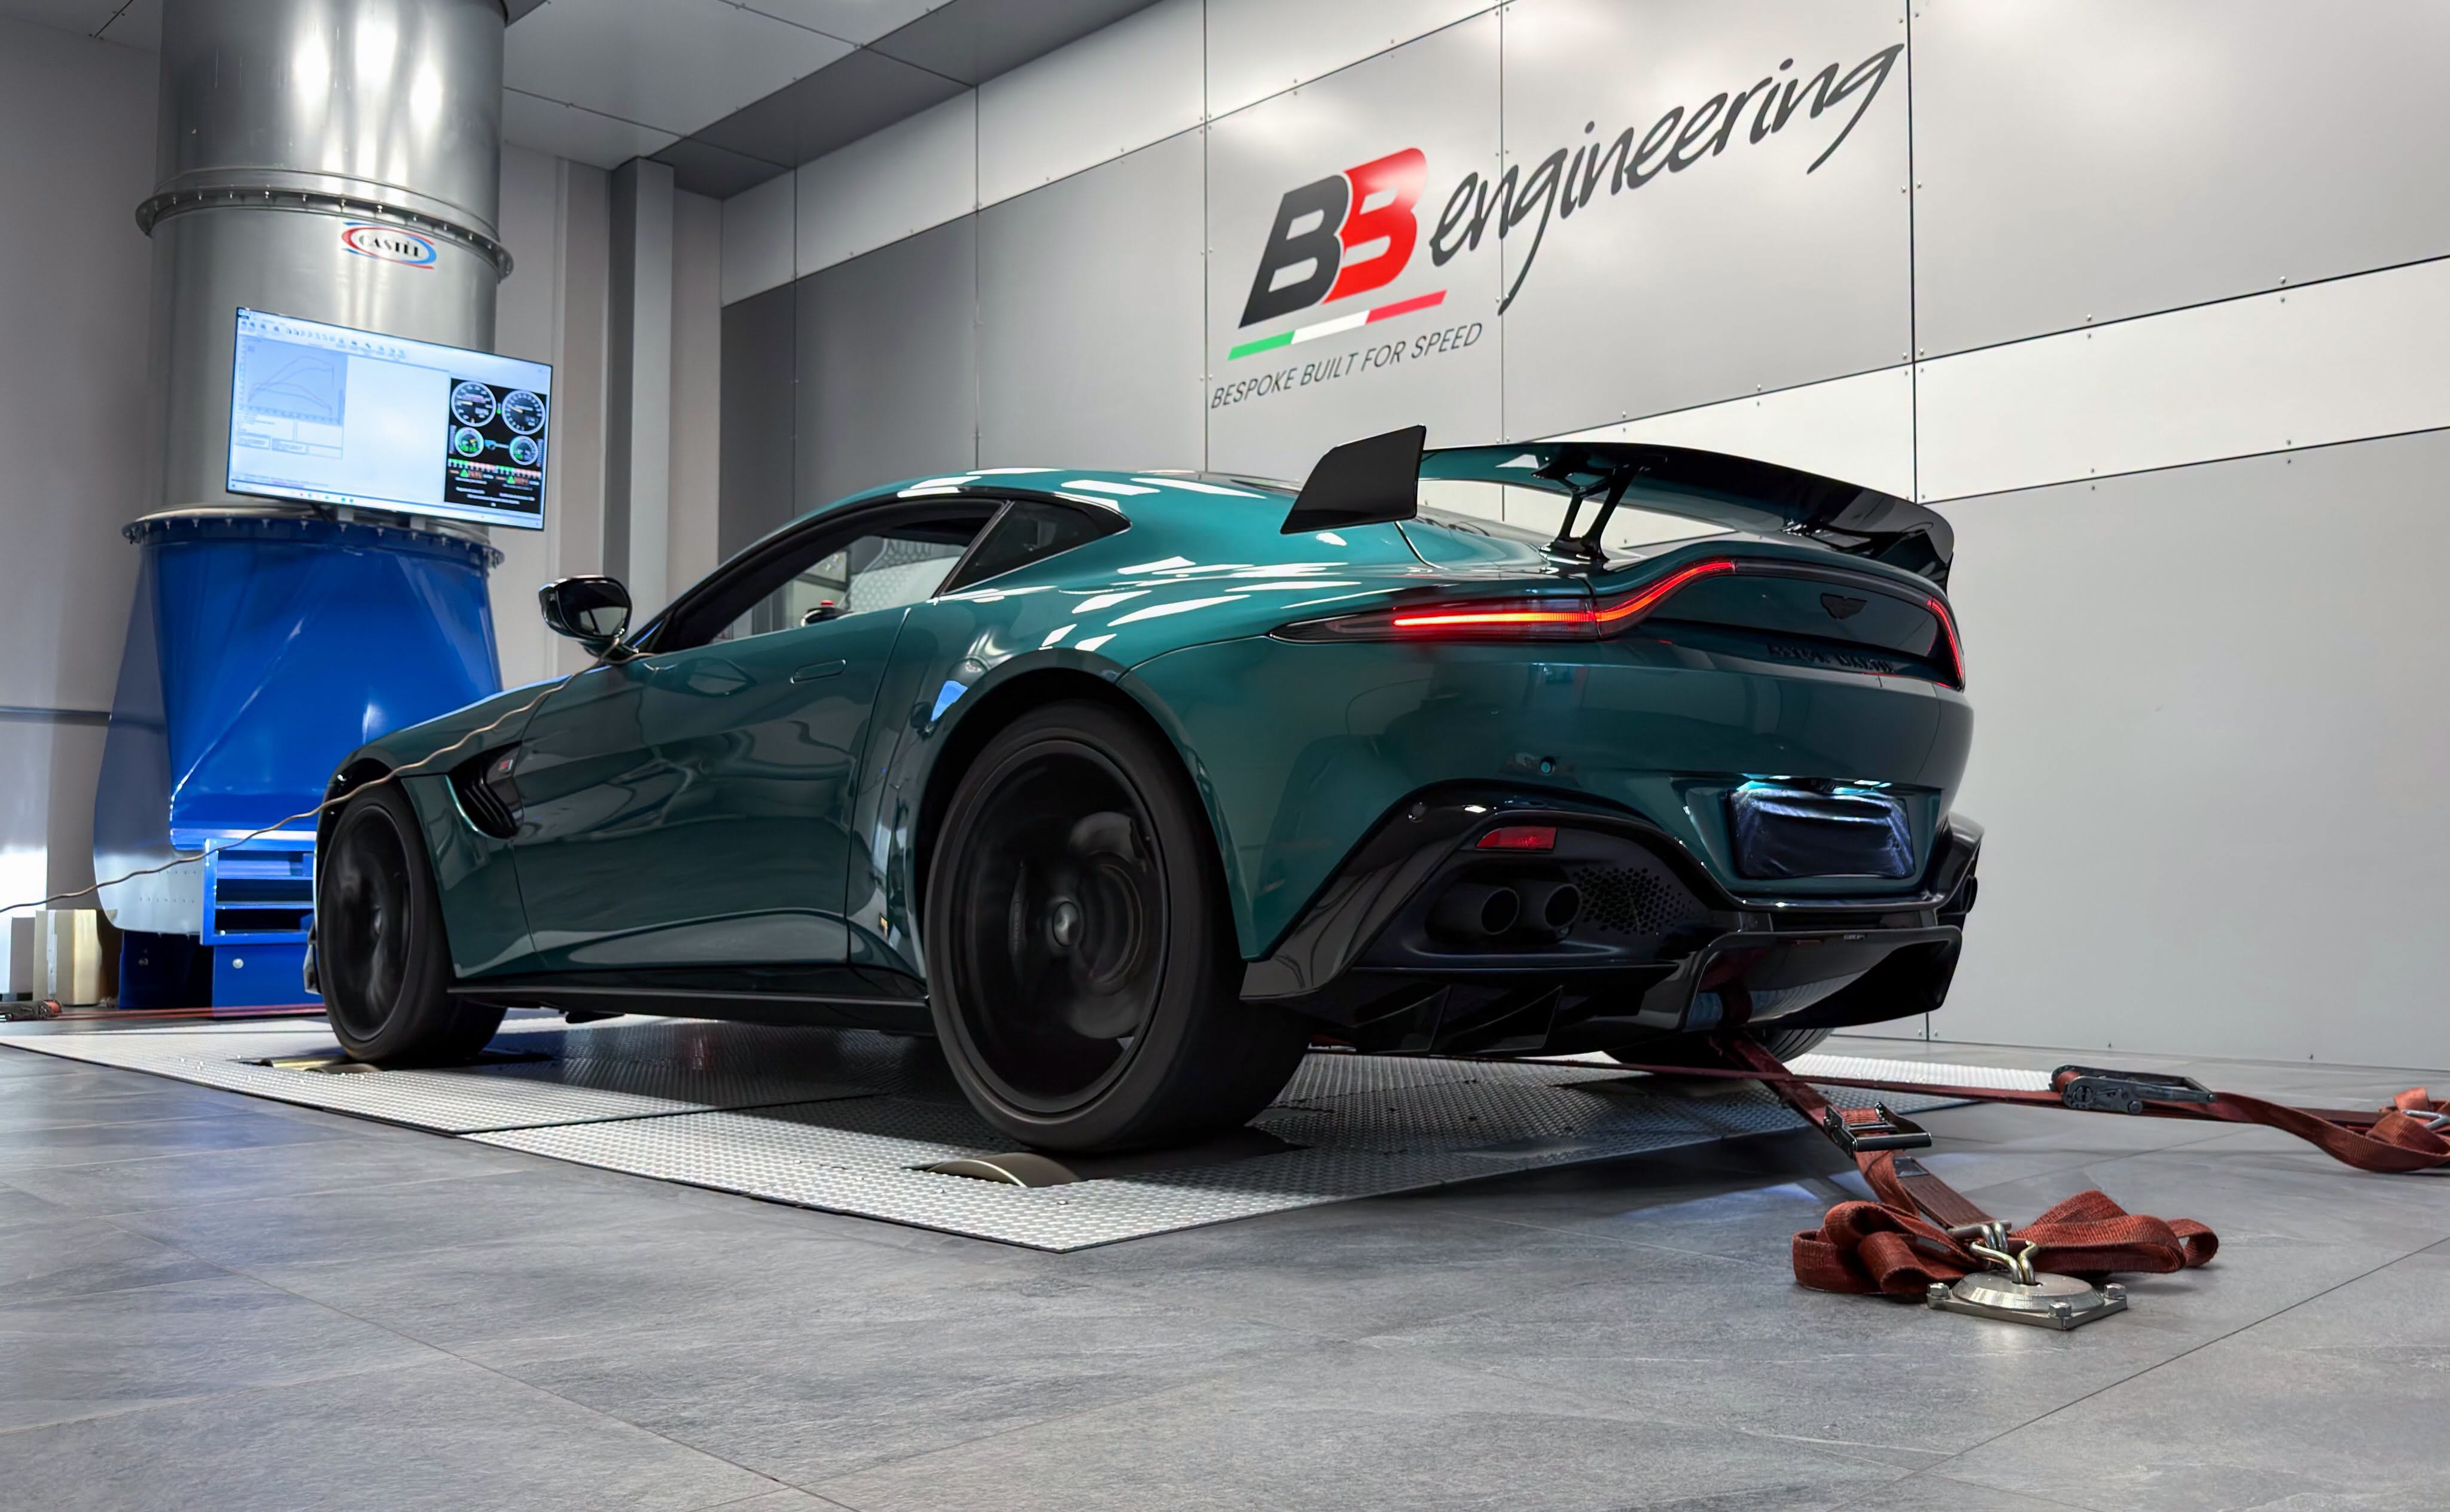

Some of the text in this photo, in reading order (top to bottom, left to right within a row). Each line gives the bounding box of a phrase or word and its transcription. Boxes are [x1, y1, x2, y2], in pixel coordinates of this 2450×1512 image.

[1238, 43, 1905, 329] BB engineering
[1211, 322, 1482, 409] BESPOKE BUILT FOR SPEED
